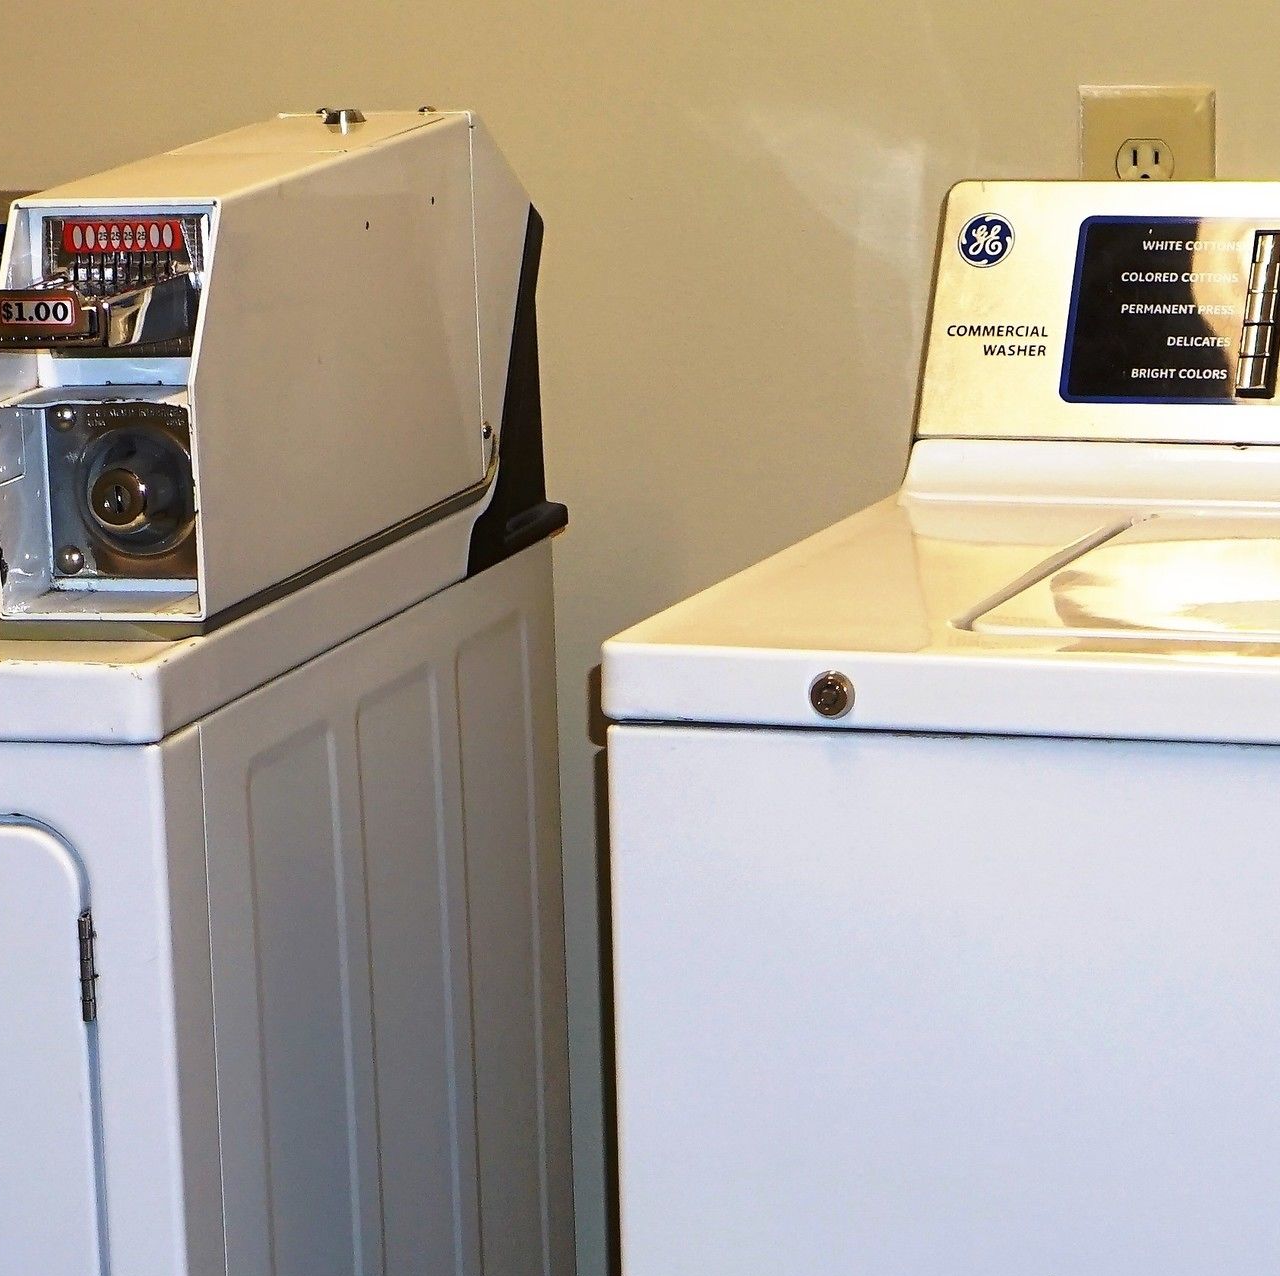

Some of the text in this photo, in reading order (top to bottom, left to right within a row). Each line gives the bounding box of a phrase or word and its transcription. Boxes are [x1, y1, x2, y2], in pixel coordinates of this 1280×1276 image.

[1143, 240, 1242, 251] WHITE COTTONS
[1121, 272, 1239, 283] COLORED COTTONS
[1, 302, 69, 322] $1.00
[1121, 303, 1234, 315] PERMANENT PRESS
[947, 325, 1049, 338] COMMERCIAL
[1167, 336, 1232, 347] DELICATES
[983, 344, 1047, 357] WASHER
[1131, 368, 1228, 380] BRIGHT COLORS
